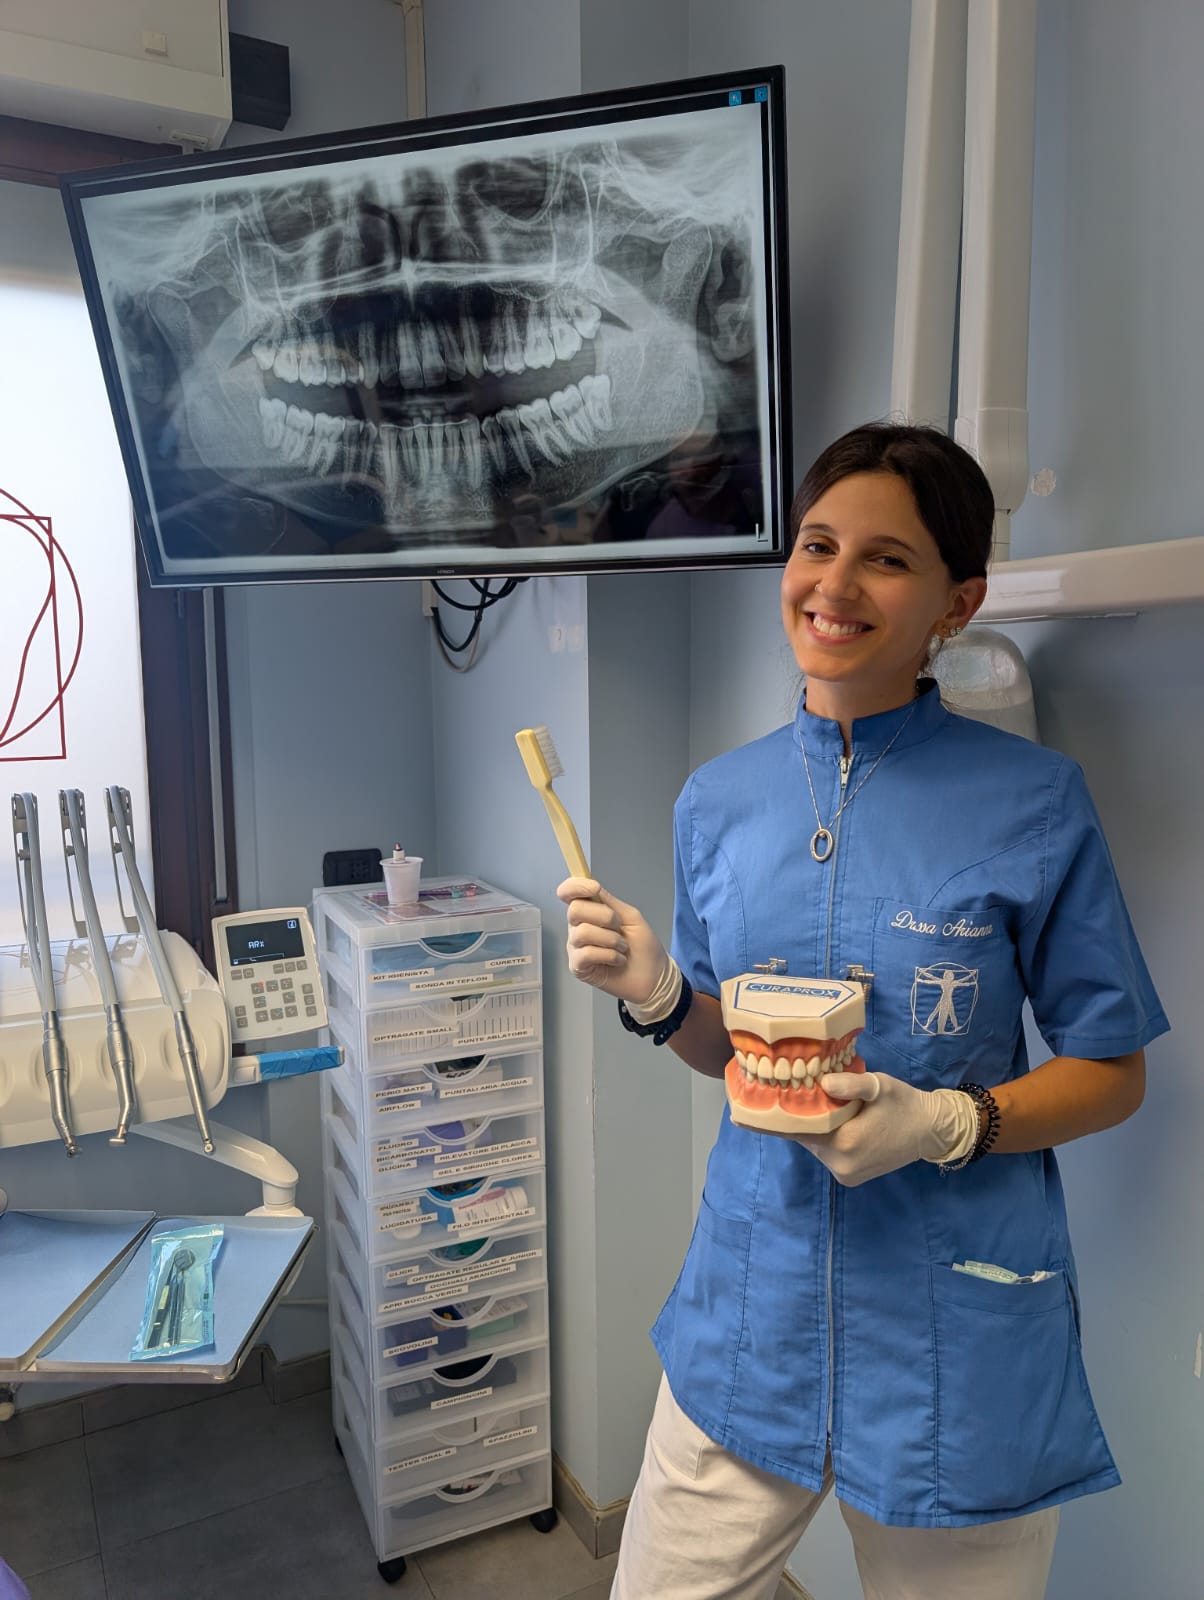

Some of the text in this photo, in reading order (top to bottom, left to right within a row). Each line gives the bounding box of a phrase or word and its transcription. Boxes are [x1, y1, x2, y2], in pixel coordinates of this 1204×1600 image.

[490, 958, 526, 967] CURETTE
[456, 976, 488, 984] TEFLON
[749, 984, 835, 997] CURAPROX
[378, 1103, 416, 1112] AIRFLOW
[378, 1141, 413, 1150] FLUORO
[380, 1215, 432, 1230] LUCIDATURA
[452, 1221, 470, 1229] FILO
